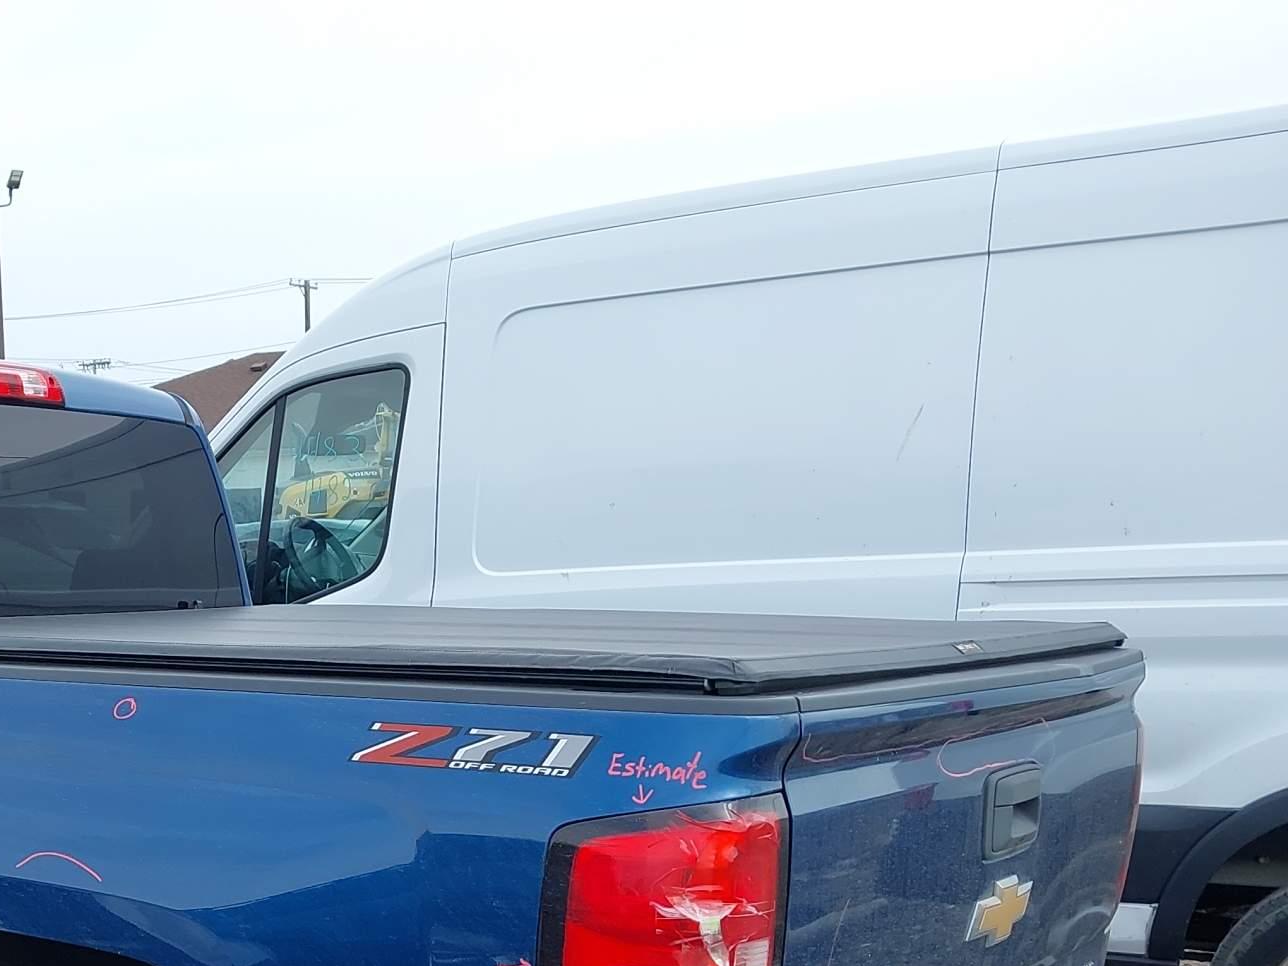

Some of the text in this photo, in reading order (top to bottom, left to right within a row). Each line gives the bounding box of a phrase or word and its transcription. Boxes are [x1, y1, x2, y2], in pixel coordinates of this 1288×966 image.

[349, 721, 600, 772] Z71
[448, 760, 571, 777] OFF ROAD
[607, 751, 708, 790] Estimate
